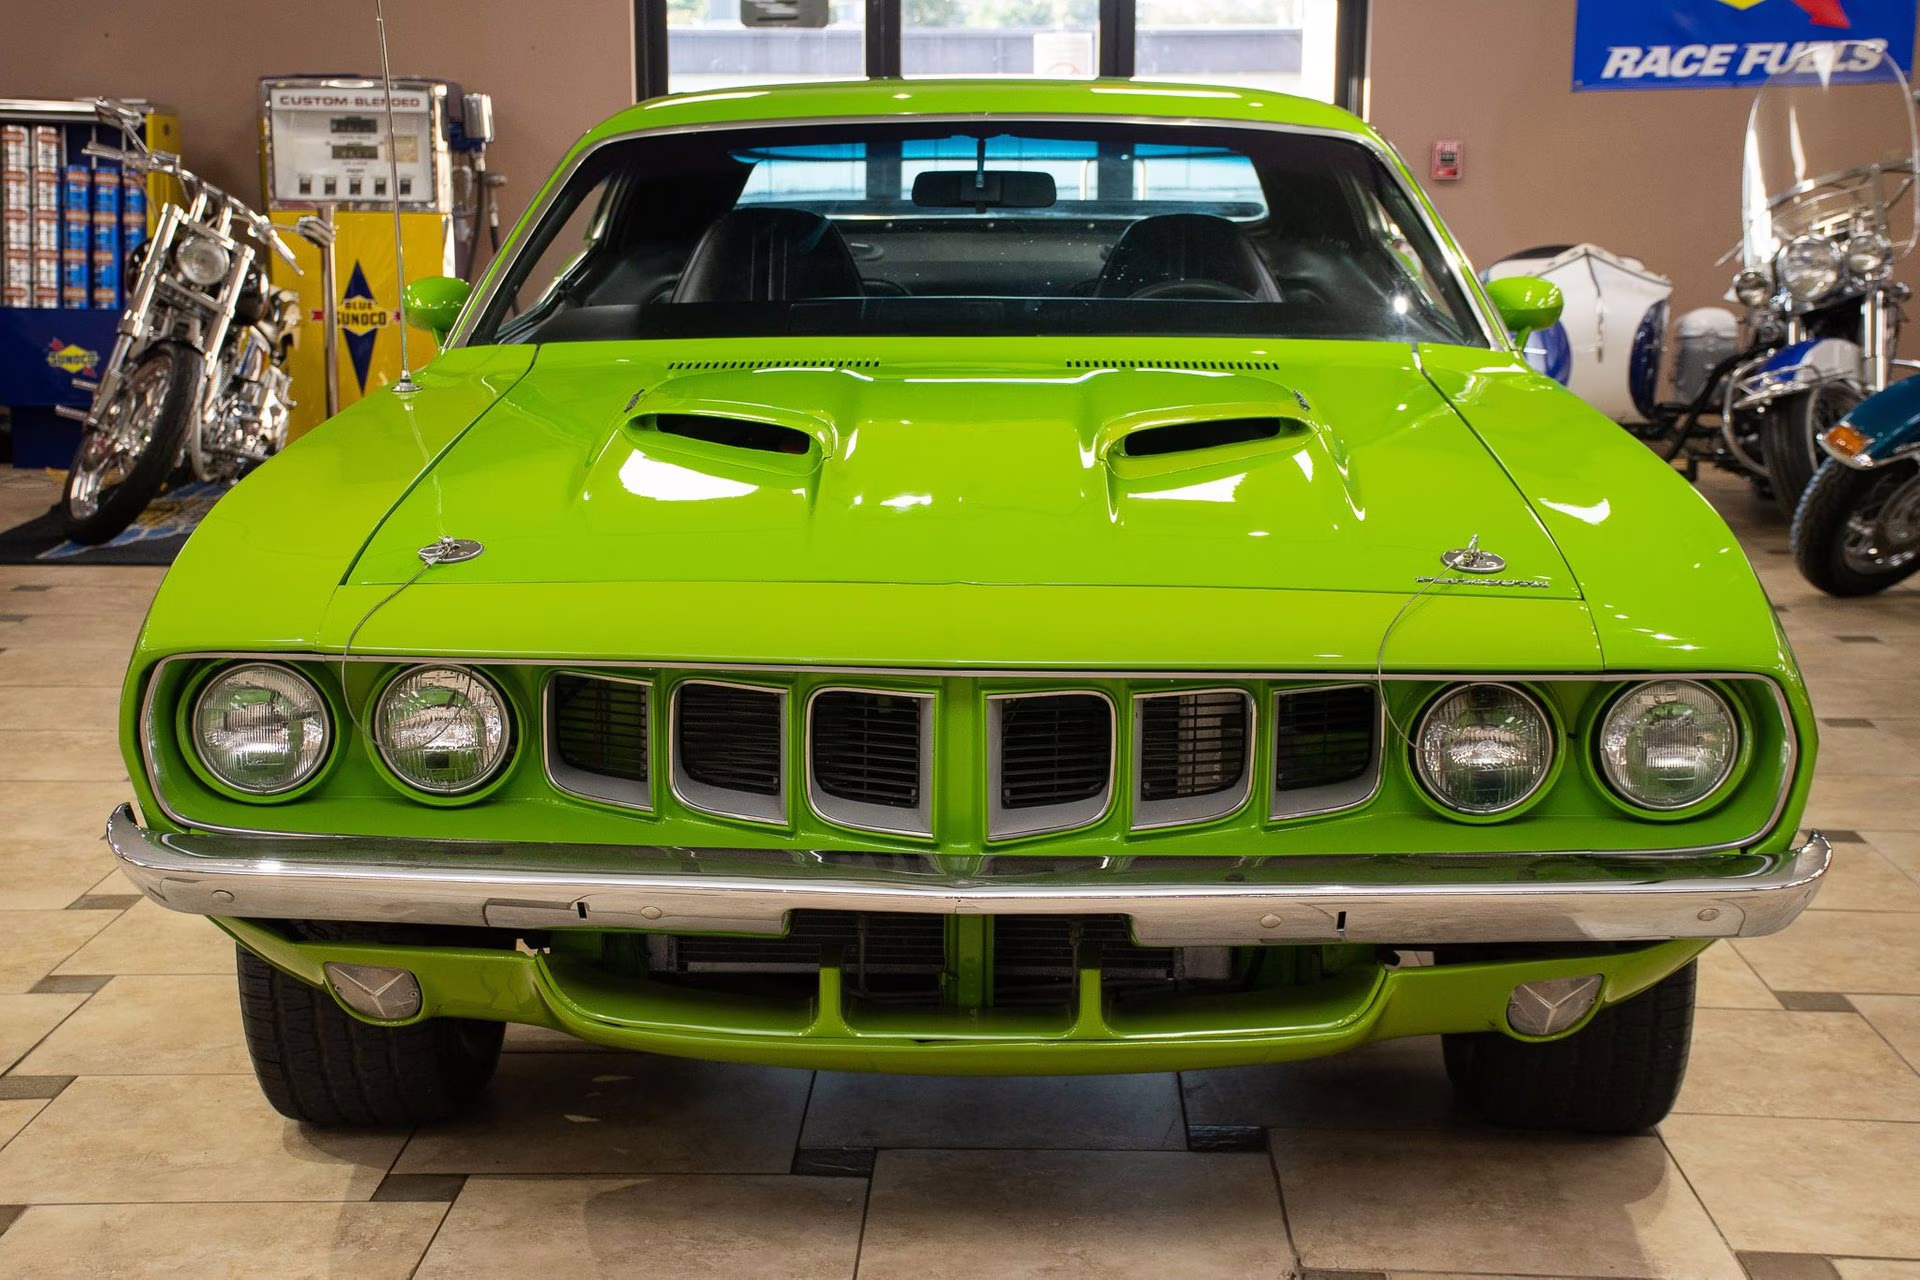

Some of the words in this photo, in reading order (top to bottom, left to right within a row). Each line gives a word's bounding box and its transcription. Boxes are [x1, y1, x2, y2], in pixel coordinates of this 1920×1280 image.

[1601, 46, 1738, 78] RACE
[1736, 38, 1887, 76] FUELS
[280, 96, 348, 106] CUSTOM
